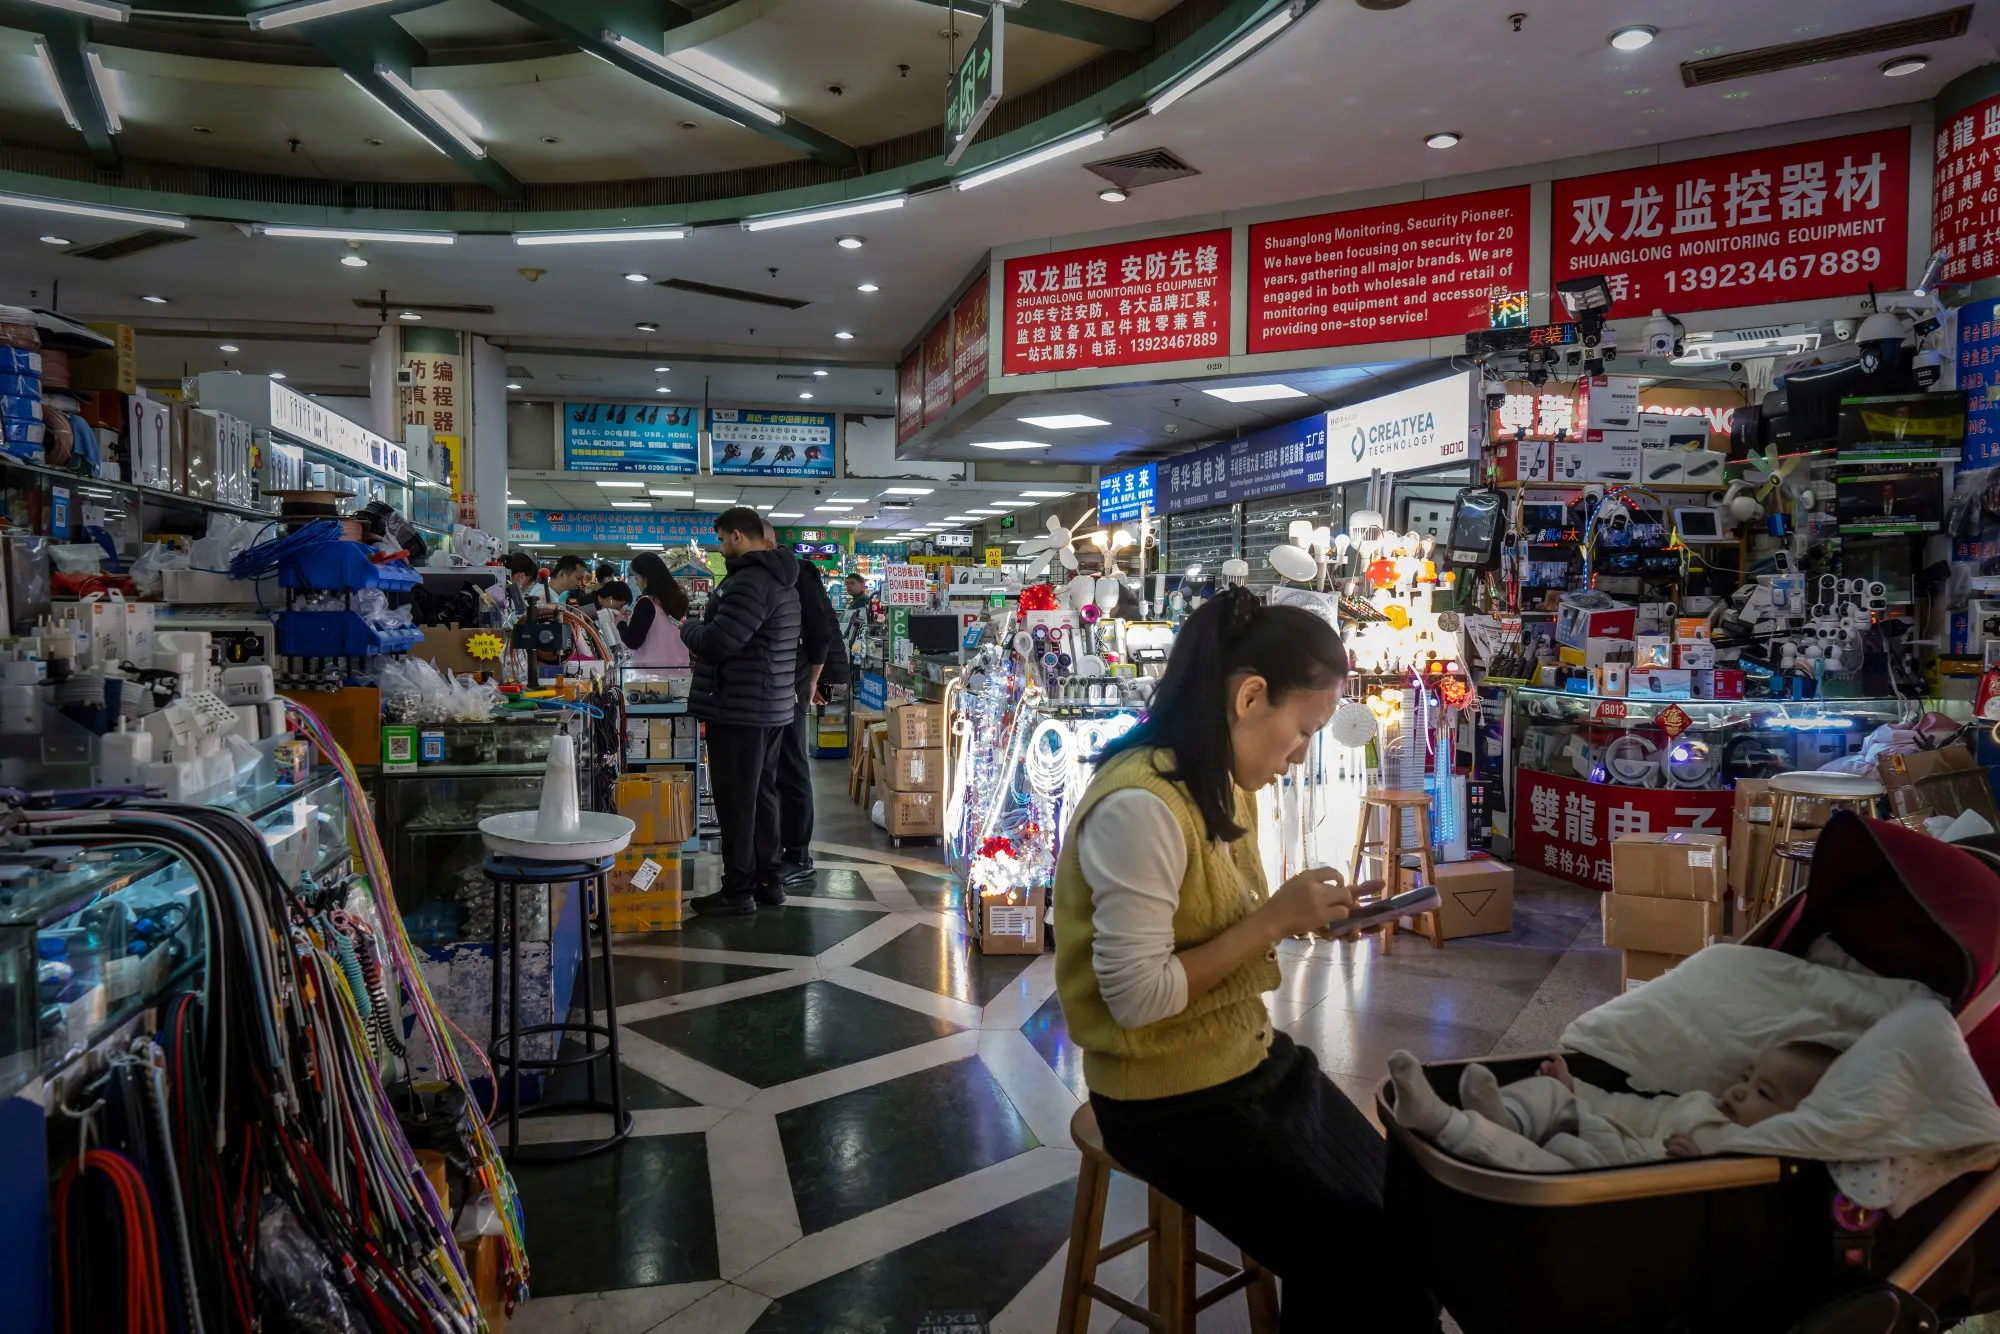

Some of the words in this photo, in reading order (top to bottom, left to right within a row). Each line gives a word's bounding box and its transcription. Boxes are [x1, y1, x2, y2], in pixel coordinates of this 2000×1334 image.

[1569, 152, 1886, 245] 双龙监控器材
[1940, 204, 1953, 223] LED
[1957, 194, 1974, 215] IPS
[1264, 230, 1332, 250] Shuanglong
[1335, 221, 1404, 240] Monitoring,
[1407, 213, 1458, 231] Security
[1461, 207, 1514, 223] Pioneer.
[1569, 245, 1672, 270] SHUANGLONG
[1679, 231, 1780, 257] MONITORING
[1788, 218, 1886, 244] EQUIPMENT
[1958, 233, 1977, 255] 海康
[1264, 256, 1282, 269] We
[1285, 253, 1312, 267] have
[1315, 250, 1343, 264] been
[1346, 242, 1399, 262] focusing
[1402, 240, 1417, 252] on
[1420, 231, 1472, 250] security
[1475, 229, 1495, 244] for
[1497, 226, 1514, 241] 20
[1017, 259, 1108, 294] 双龙监控
[1121, 245, 1219, 283] 安防先锋
[1263, 286, 1313, 306] engaged
[1316, 283, 1328, 297] in
[1331, 281, 1360, 296] both
[1363, 274, 1427, 293] wholesale
[1431, 269, 1455, 285] and
[1459, 265, 1495, 281] retail
[1499, 262, 1513, 277] of
[1264, 272, 1298, 289] years,
[1300, 262, 1358, 285] gathering
[1360, 261, 1376, 275] all
[1378, 256, 1414, 275] major
[1417, 252, 1465, 269] brands.
[1468, 249, 1488, 263] We
[1492, 247, 1513, 260] are
[1663, 246, 1881, 293] 13923467889
[1016, 292, 1083, 308] SHUANGLONG
[1087, 284, 1152, 300] MONITORING
[1156, 276, 1219, 293] EQUIPMENT
[1263, 301, 1328, 321] monitoring
[1332, 295, 1399, 315] equipment
[1403, 291, 1427, 305] and
[1262, 320, 1318, 340] providing
[1320, 313, 1377, 332] one-stop
[1379, 308, 1428, 325] service!
[1130, 332, 1218, 353] 13923467889
[1206, 363, 1223, 371] 029
[407, 359, 428, 425] 仿真机
[432, 361, 454, 433] 编程器
[1305, 430, 1325, 448] 工厂店
[1368, 411, 1435, 444] CREATYEA
[1368, 433, 1435, 457] TECHNOLOGY
[1111, 468, 1149, 495] 兴宝来
[1170, 454, 1226, 494] 得华通电池
[990, 558, 998, 567] 电
[1601, 702, 1625, 717] 1B012
[1543, 844, 1612, 885] 赛格分店
[920, 1312, 977, 1325] EXIT
